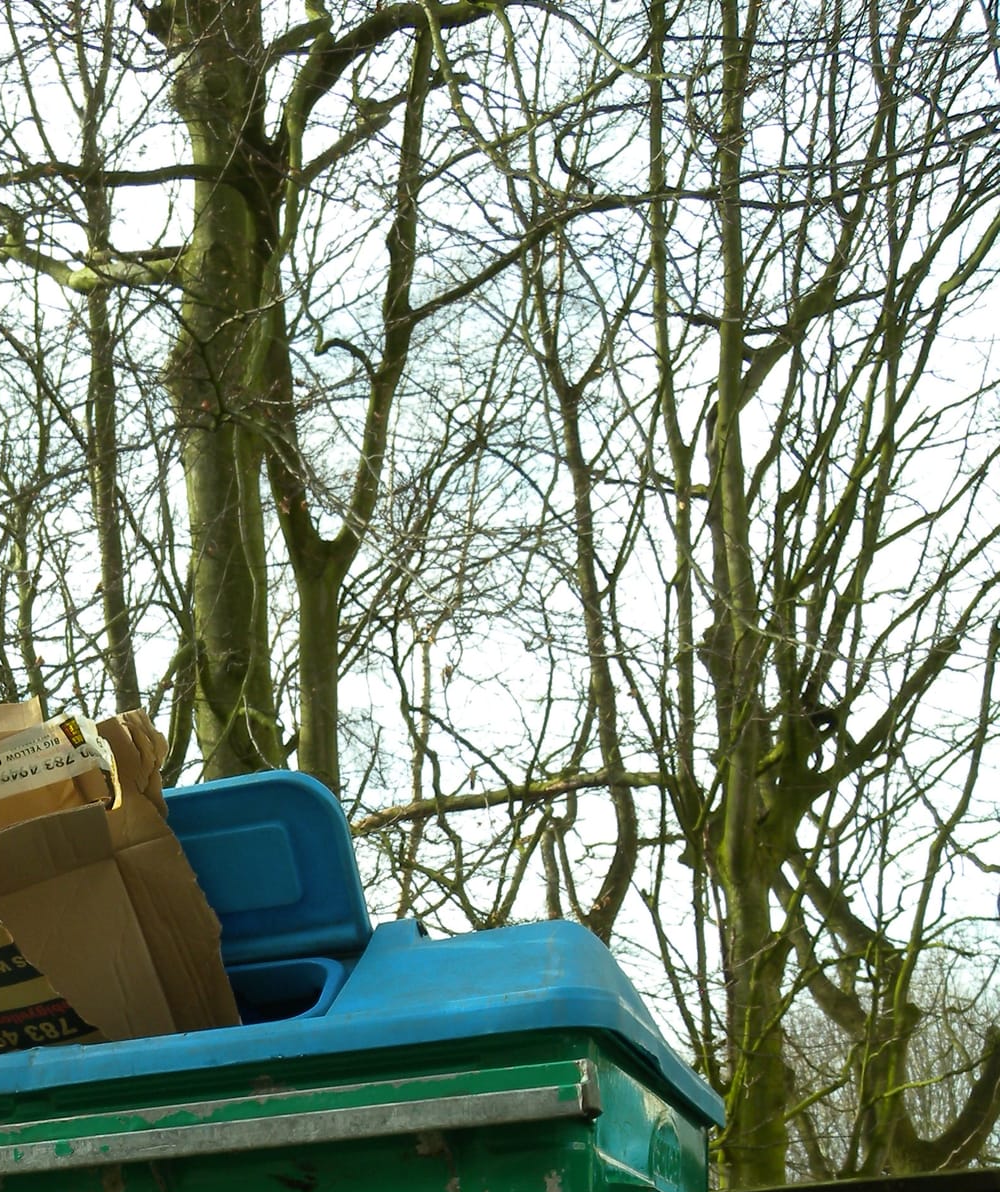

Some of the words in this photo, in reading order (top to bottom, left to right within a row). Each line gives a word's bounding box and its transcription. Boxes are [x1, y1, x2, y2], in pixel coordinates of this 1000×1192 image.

[43, 737, 60, 751] BIG
[5, 745, 42, 762] YELLOW
[23, 1017, 79, 1042] 783
